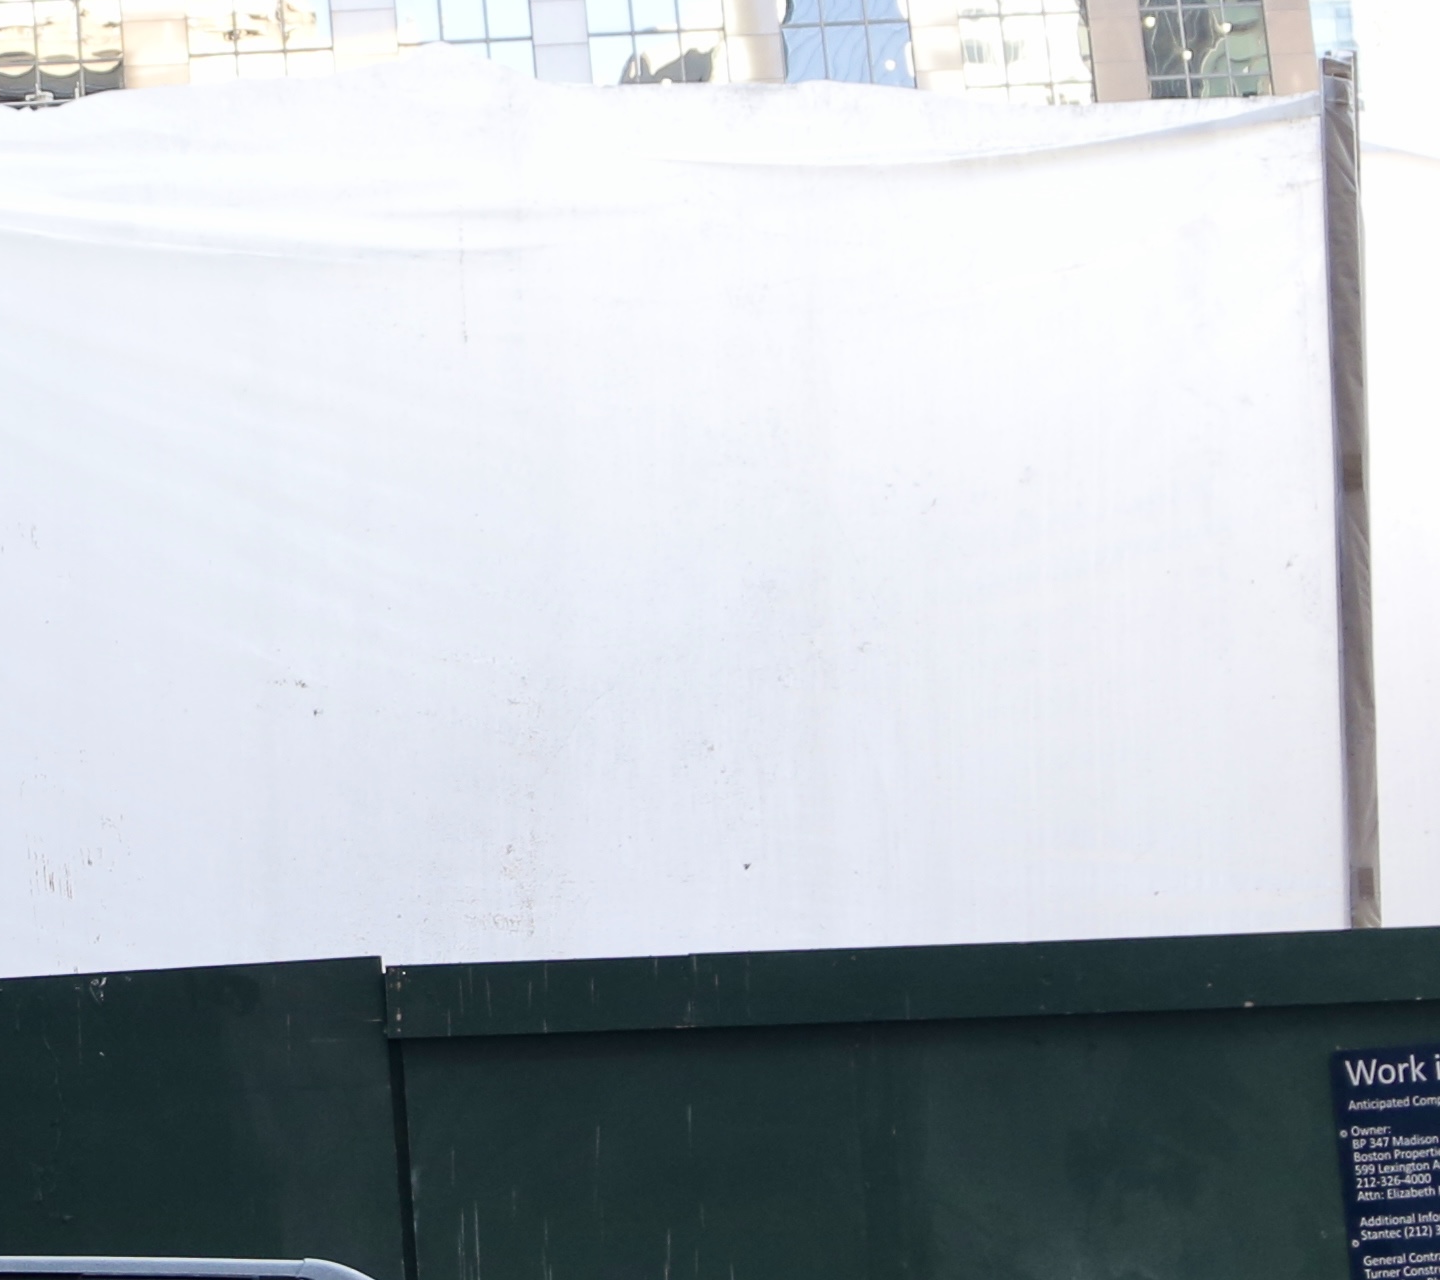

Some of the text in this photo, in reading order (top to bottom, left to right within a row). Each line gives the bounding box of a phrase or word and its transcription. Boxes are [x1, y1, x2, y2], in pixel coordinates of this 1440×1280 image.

[1345, 1053, 1427, 1086] Work
[1348, 1096, 1410, 1111] Anticipated
[1351, 1126, 1392, 1137] Owner:
[1352, 1138, 1367, 1150] BP
[1369, 1137, 1389, 1149] 347
[1392, 1134, 1439, 1147] Madison
[1353, 1151, 1392, 1162] Boston
[1354, 1164, 1376, 1176] 599
[1378, 1162, 1430, 1174] Lexington
[1356, 1173, 1432, 1189] 212-326-4000
[1357, 1191, 1385, 1201] Attn:
[1387, 1186, 1436, 1200] Elizabeth
[1360, 1213, 1416, 1227] Additional
[1360, 1229, 1402, 1241] Stantec
[1404, 1225, 1433, 1239] (212)
[1363, 1253, 1406, 1267] General
[1364, 1269, 1401, 1279] Turner
